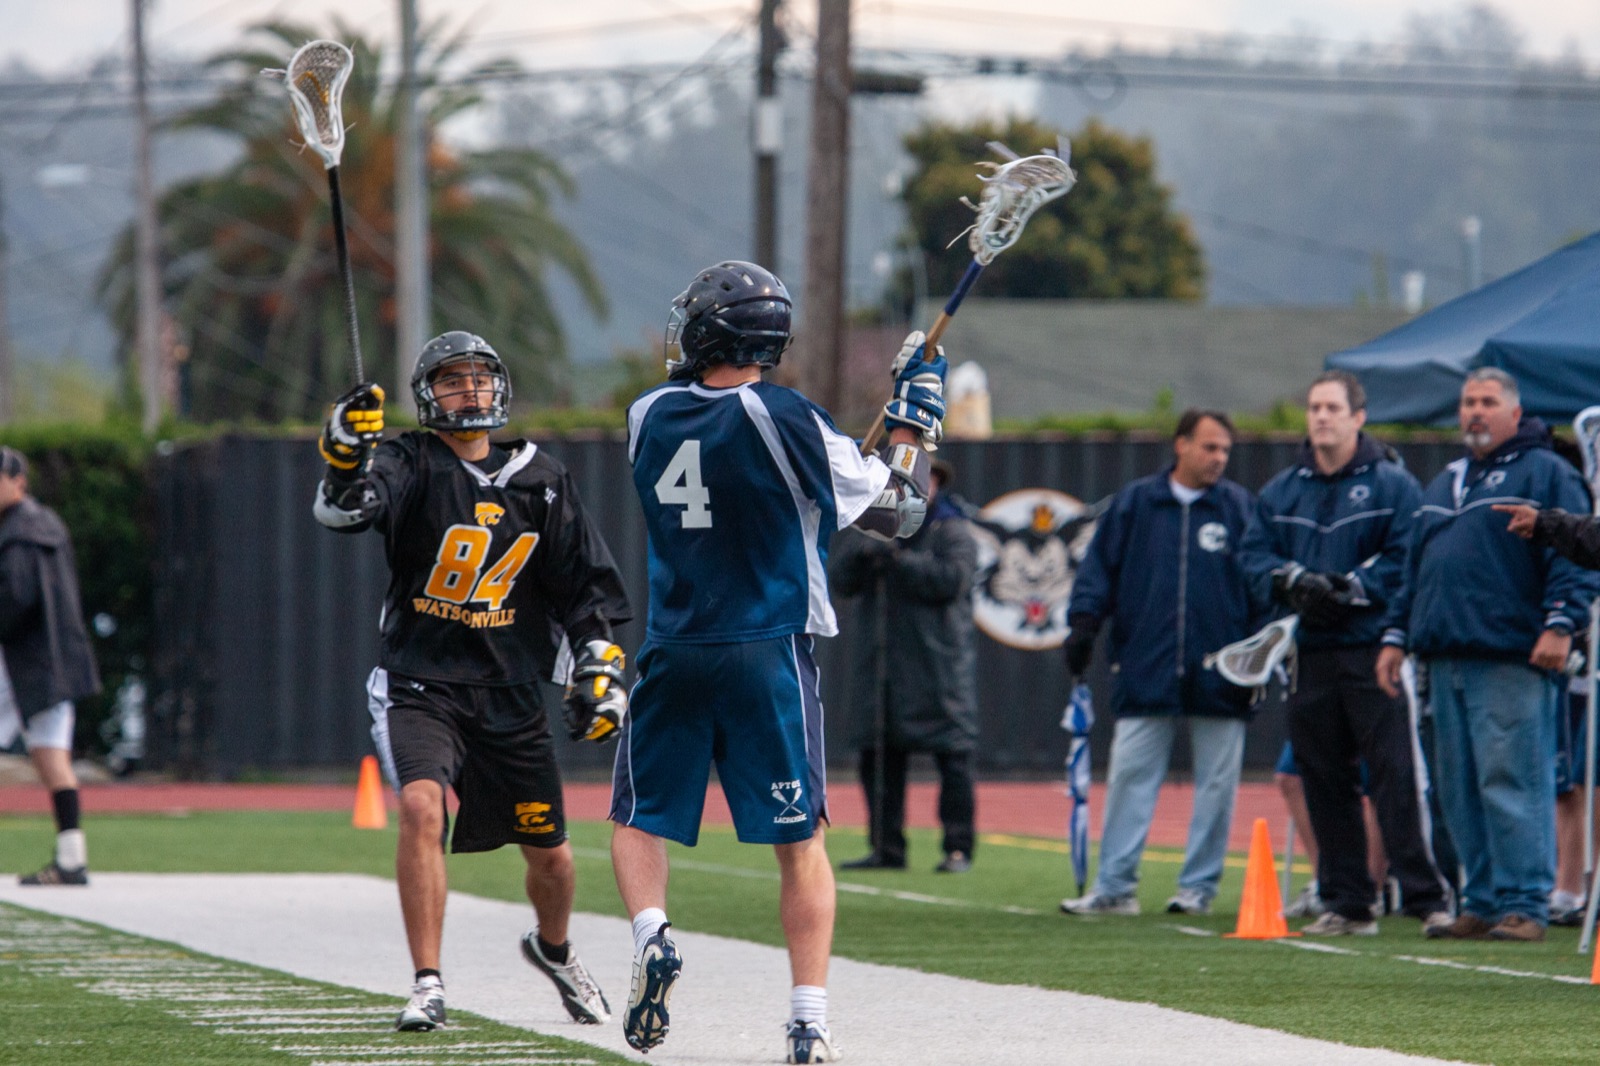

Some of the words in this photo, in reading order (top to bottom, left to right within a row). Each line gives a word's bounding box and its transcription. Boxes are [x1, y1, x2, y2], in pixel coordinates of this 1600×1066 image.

[654, 439, 713, 529] 4
[424, 523, 540, 611] 84
[412, 597, 516, 629] WATSONVILLE
[771, 779, 801, 791] APTOS
